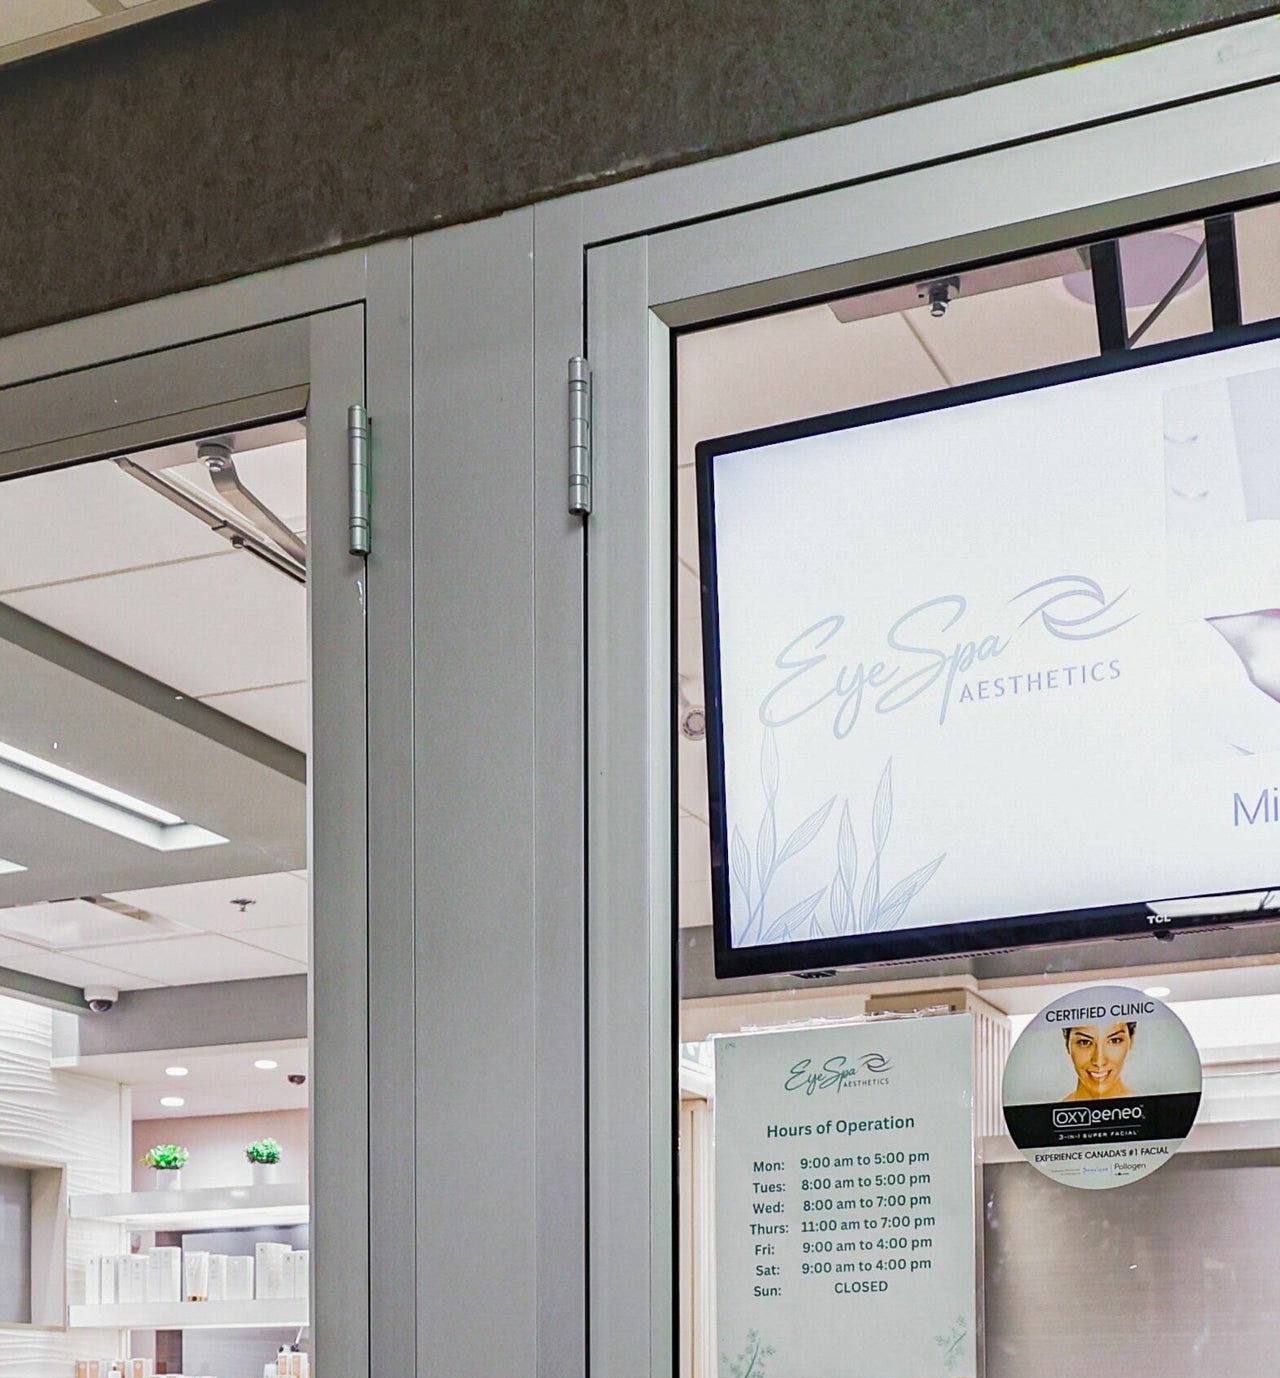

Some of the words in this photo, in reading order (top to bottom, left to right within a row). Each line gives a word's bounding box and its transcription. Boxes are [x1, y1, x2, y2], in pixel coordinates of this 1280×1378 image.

[959, 659, 1122, 702] AESTHETICS
[1146, 914, 1172, 924] TCL
[1045, 1006, 1107, 1023] CERTIFIED
[1110, 1001, 1155, 1017] CLINIC
[843, 1078, 890, 1088] AESTHETICS
[767, 1124, 812, 1138] Hours
[816, 1120, 832, 1135] of
[835, 1116, 915, 1136] Operation
[753, 1161, 785, 1172] Mon:
[800, 1156, 830, 1169] 9:00
[834, 1158, 853, 1167] am
[857, 1155, 870, 1166] to
[874, 1152, 904, 1164] 5:00
[909, 1152, 930, 1165] pm
[1035, 1152, 1083, 1163] EXPERIENCE
[1085, 1149, 1127, 1160] CANADA'S
[1140, 1146, 1169, 1156] FACIAL
[753, 1182, 786, 1194] Tues:
[801, 1178, 831, 1191] 8:00
[834, 1180, 854, 1189] am
[858, 1177, 871, 1187] to
[875, 1173, 905, 1186] 5:00
[909, 1174, 931, 1187] pm
[753, 1202, 785, 1214] Wed:
[803, 1199, 833, 1212] 8:00
[836, 1201, 856, 1210] am
[860, 1198, 873, 1208] to
[876, 1195, 906, 1207] 7:00
[910, 1195, 931, 1208] pm
[749, 1223, 789, 1235] Thurs:
[801, 1220, 837, 1233] 11:00
[840, 1222, 860, 1231] am
[864, 1218, 877, 1229] to
[880, 1216, 910, 1229] 7:00
[914, 1216, 935, 1229] pm
[755, 1244, 775, 1255] Fri:
[802, 1241, 833, 1254] 9:00
[836, 1243, 856, 1252] am
[859, 1240, 873, 1250] to
[876, 1237, 907, 1250] 4:00
[911, 1238, 933, 1251] pm
[755, 1265, 780, 1276] Sat:
[801, 1262, 832, 1275] 9:00
[835, 1264, 855, 1273] am
[859, 1261, 872, 1272] to
[875, 1259, 906, 1271] 4:00
[910, 1259, 932, 1272] pm
[753, 1286, 782, 1297] Sun:
[834, 1281, 889, 1294] CLOSED
